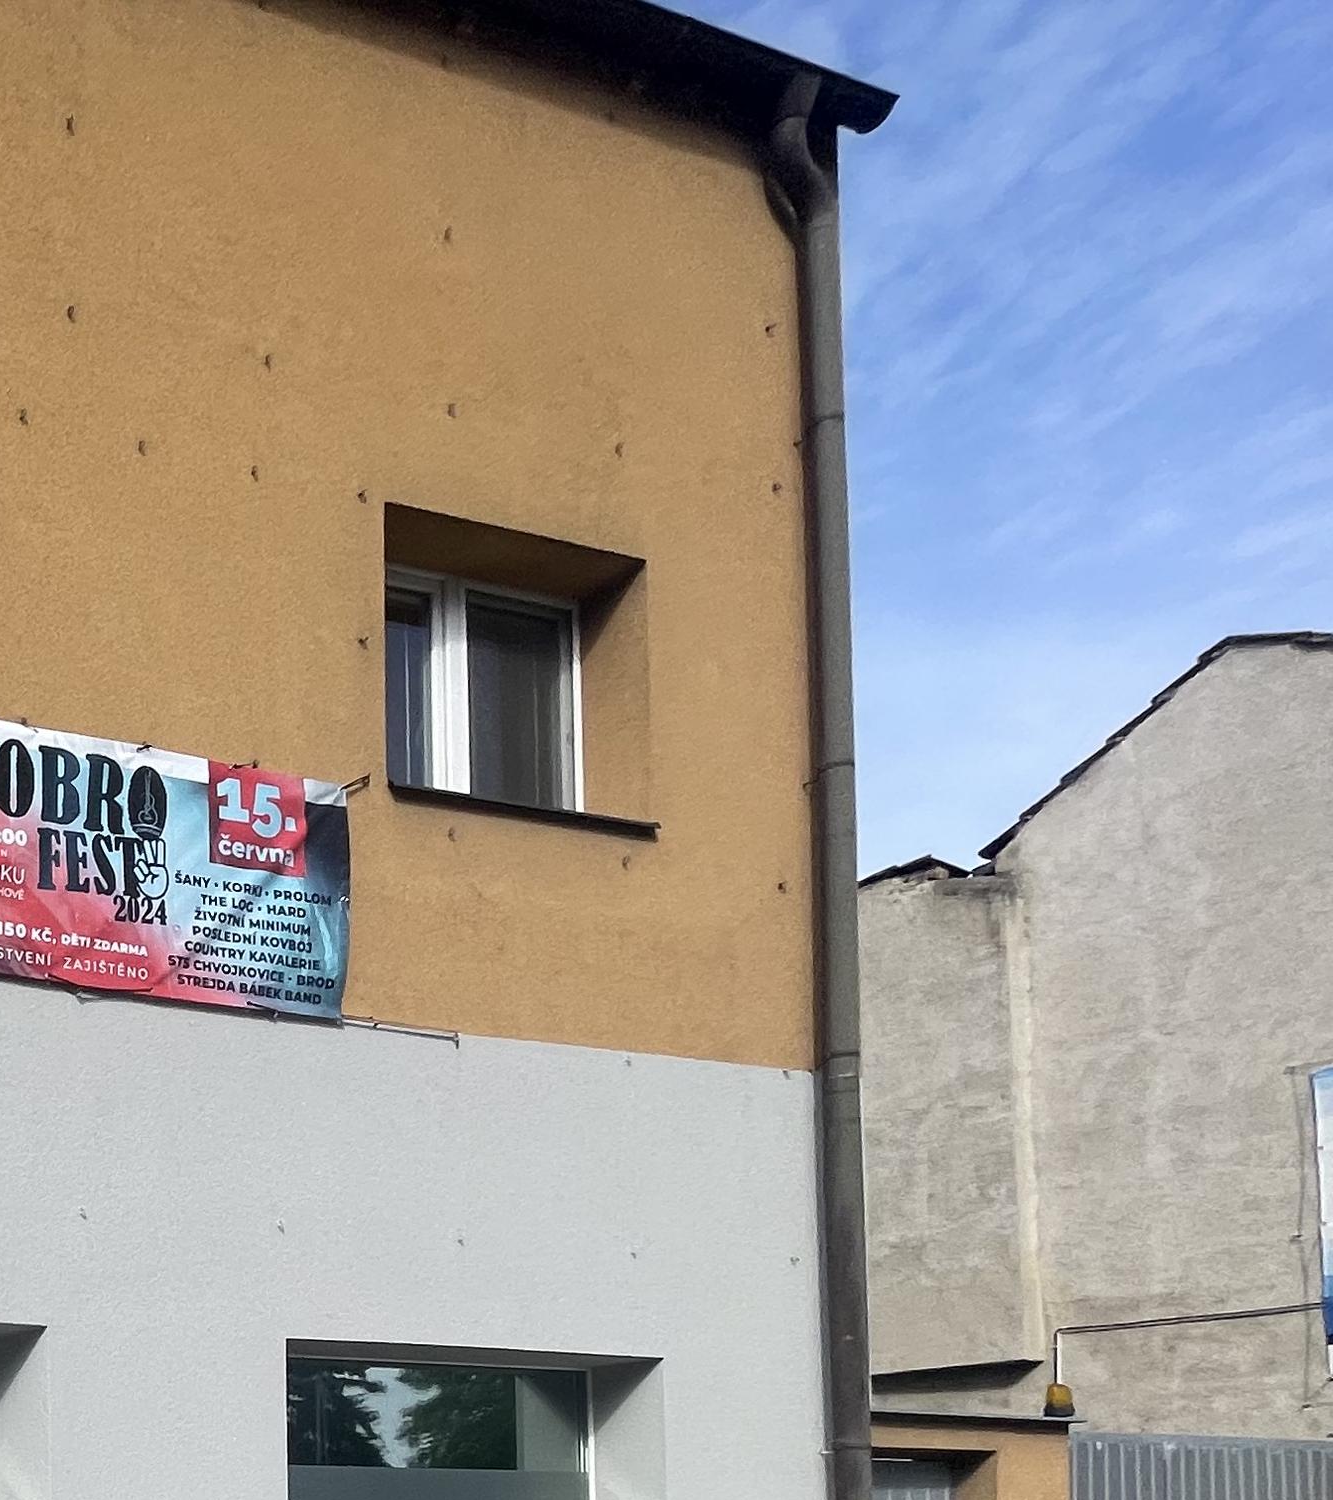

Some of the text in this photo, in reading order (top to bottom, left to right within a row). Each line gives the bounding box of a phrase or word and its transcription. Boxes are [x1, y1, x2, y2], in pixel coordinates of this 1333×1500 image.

[216, 776, 298, 838] 15.
[37, 827, 145, 898] FEST
[218, 833, 295, 868] června
[174, 870, 211, 889] ŠANY
[273, 889, 332, 906] PROLOM
[114, 895, 167, 925] 2024
[194, 906, 311, 937] ŽIVOTNÍ MINIMUM
[200, 893, 227, 907] THE
[267, 904, 307, 919] HARD
[61, 934, 91, 949] DĚTI
[93, 937, 148, 957] ZDARMA
[192, 925, 313, 954] POSLEDNÍ KOVBOJ
[184, 940, 321, 971] COUNTRY KAVALERIE
[177, 974, 236, 993] STREJDA
[284, 990, 322, 1005] BAND
[193, 959, 285, 983] CHVOJKOVICE
[297, 974, 335, 989] BROD
